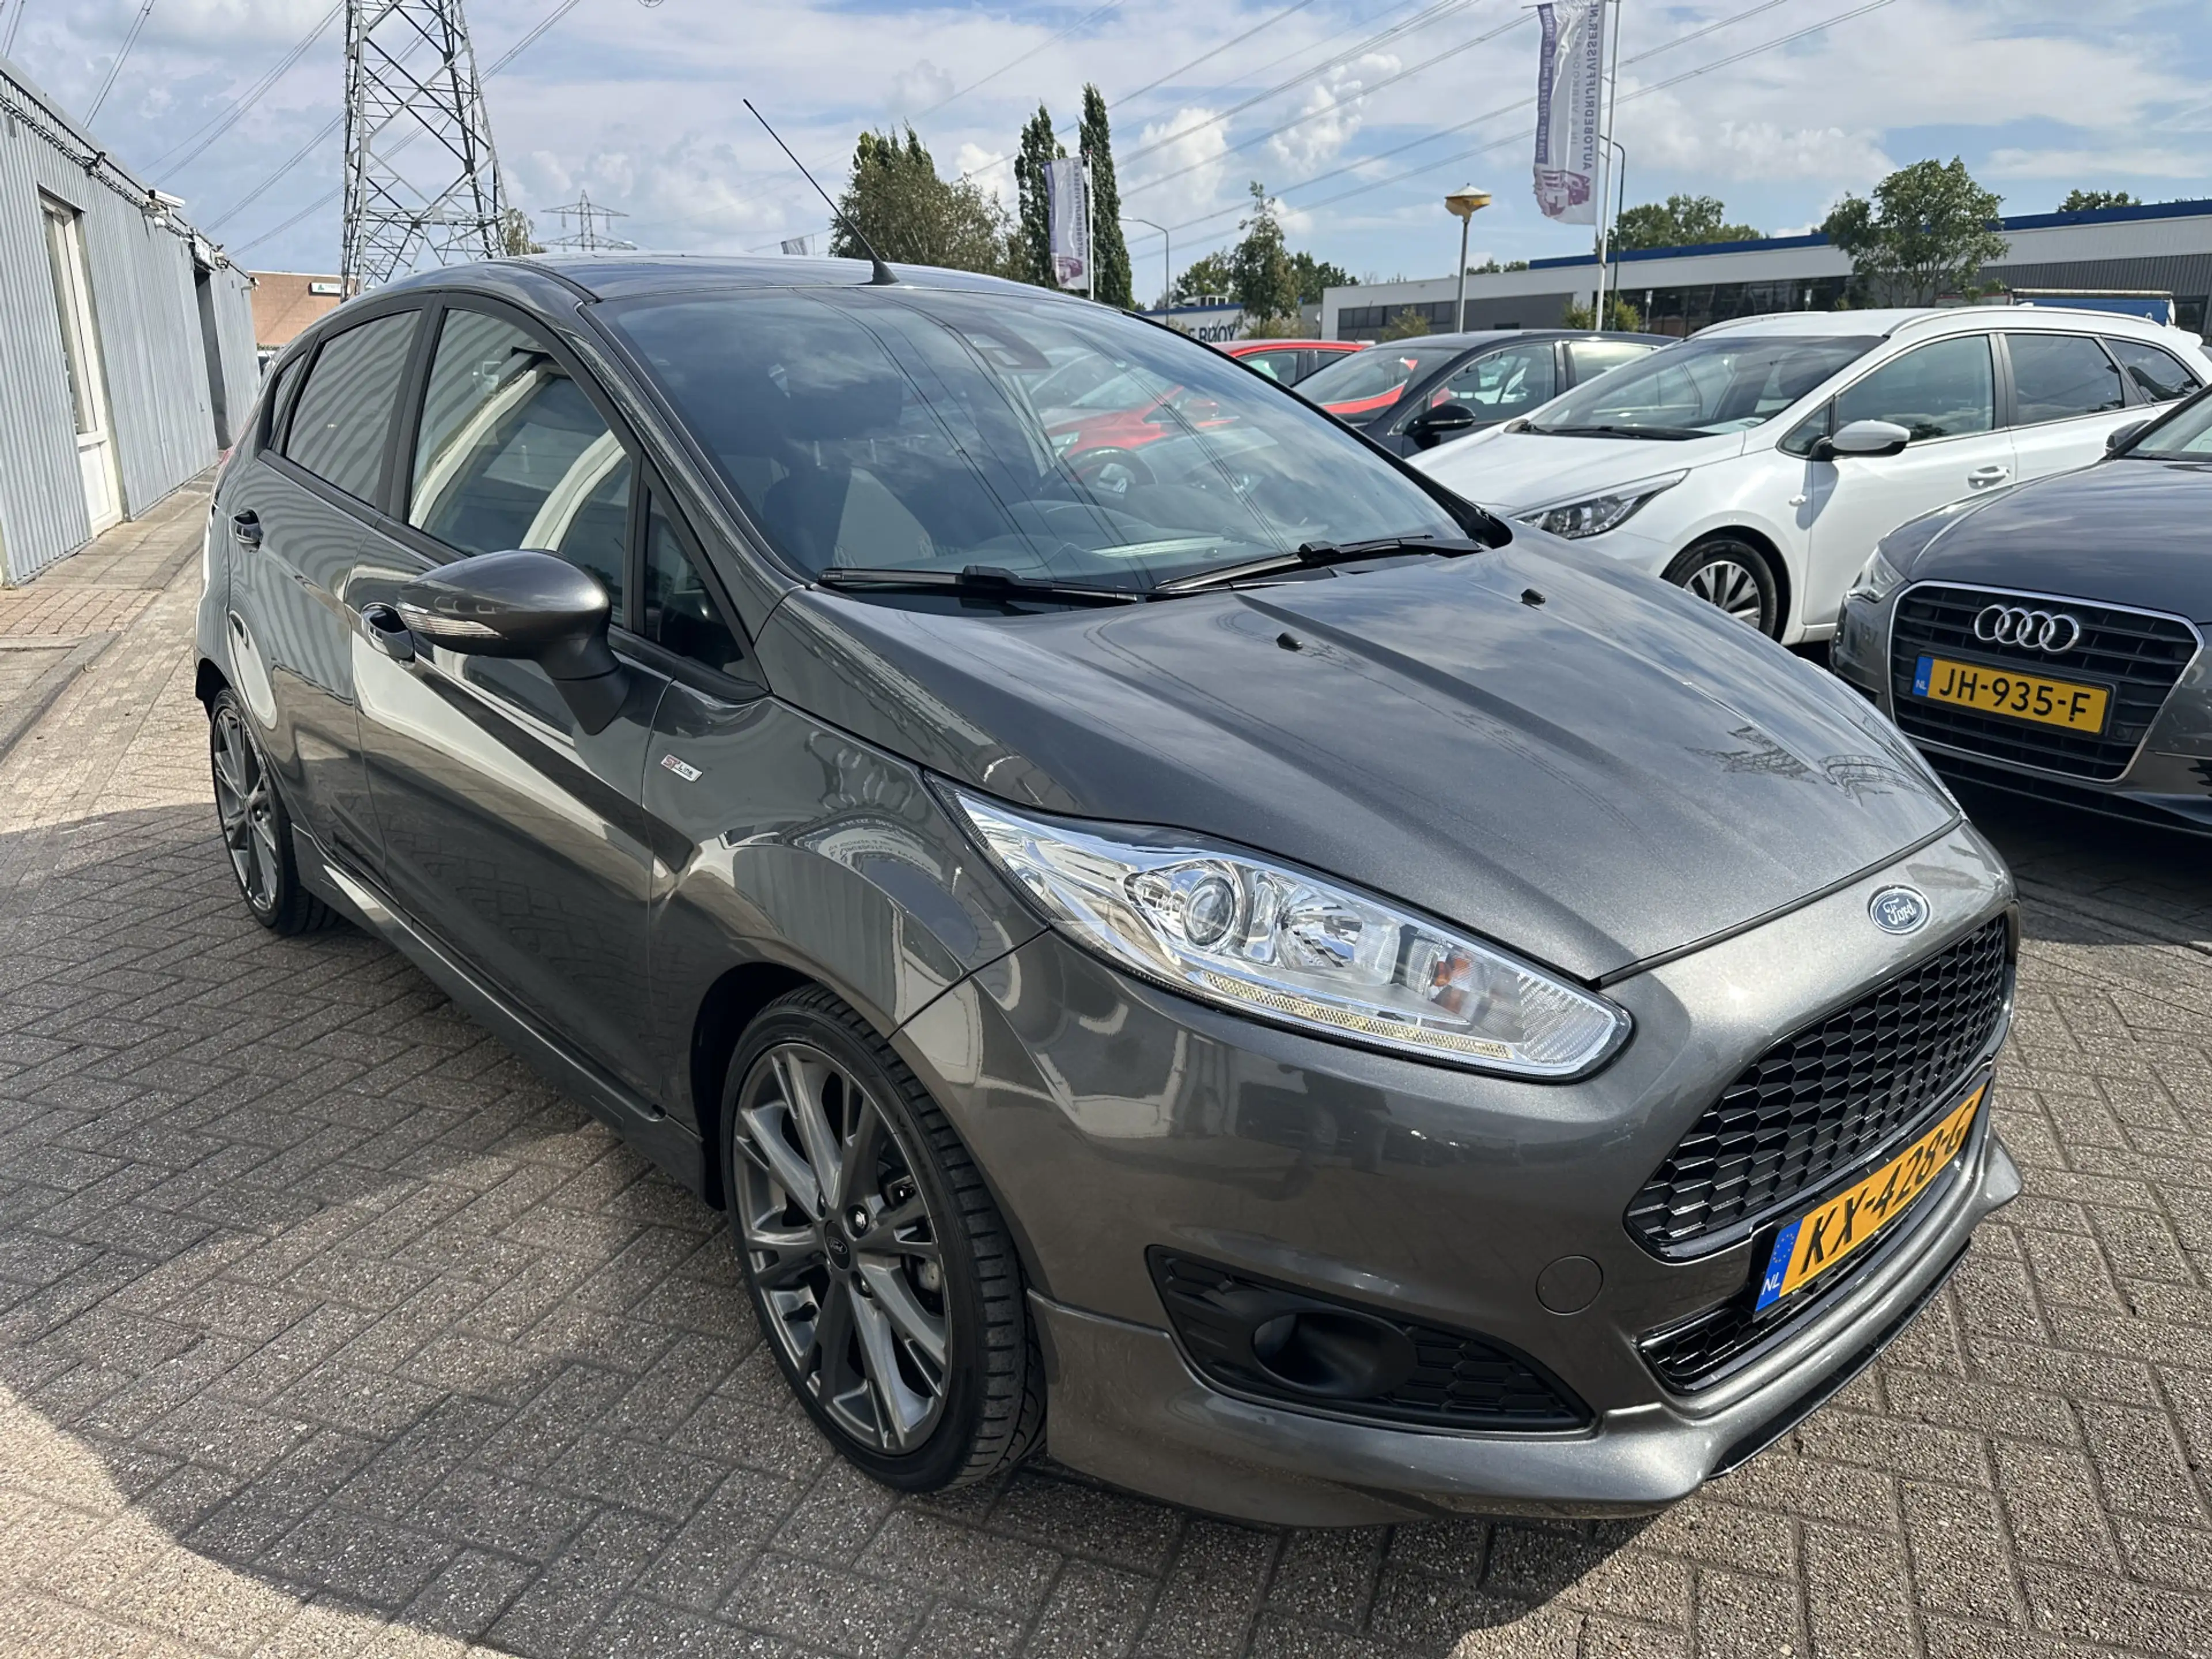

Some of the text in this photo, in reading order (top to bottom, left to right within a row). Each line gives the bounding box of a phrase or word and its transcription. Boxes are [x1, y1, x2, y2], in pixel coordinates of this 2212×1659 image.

[1916, 679, 1927, 691] NL
[1939, 668, 2090, 722] JH-935-F
[1883, 897, 1916, 925] Ford
[1800, 1098, 1975, 1276] KX-428-G
[1762, 1272, 1781, 1295] NL
